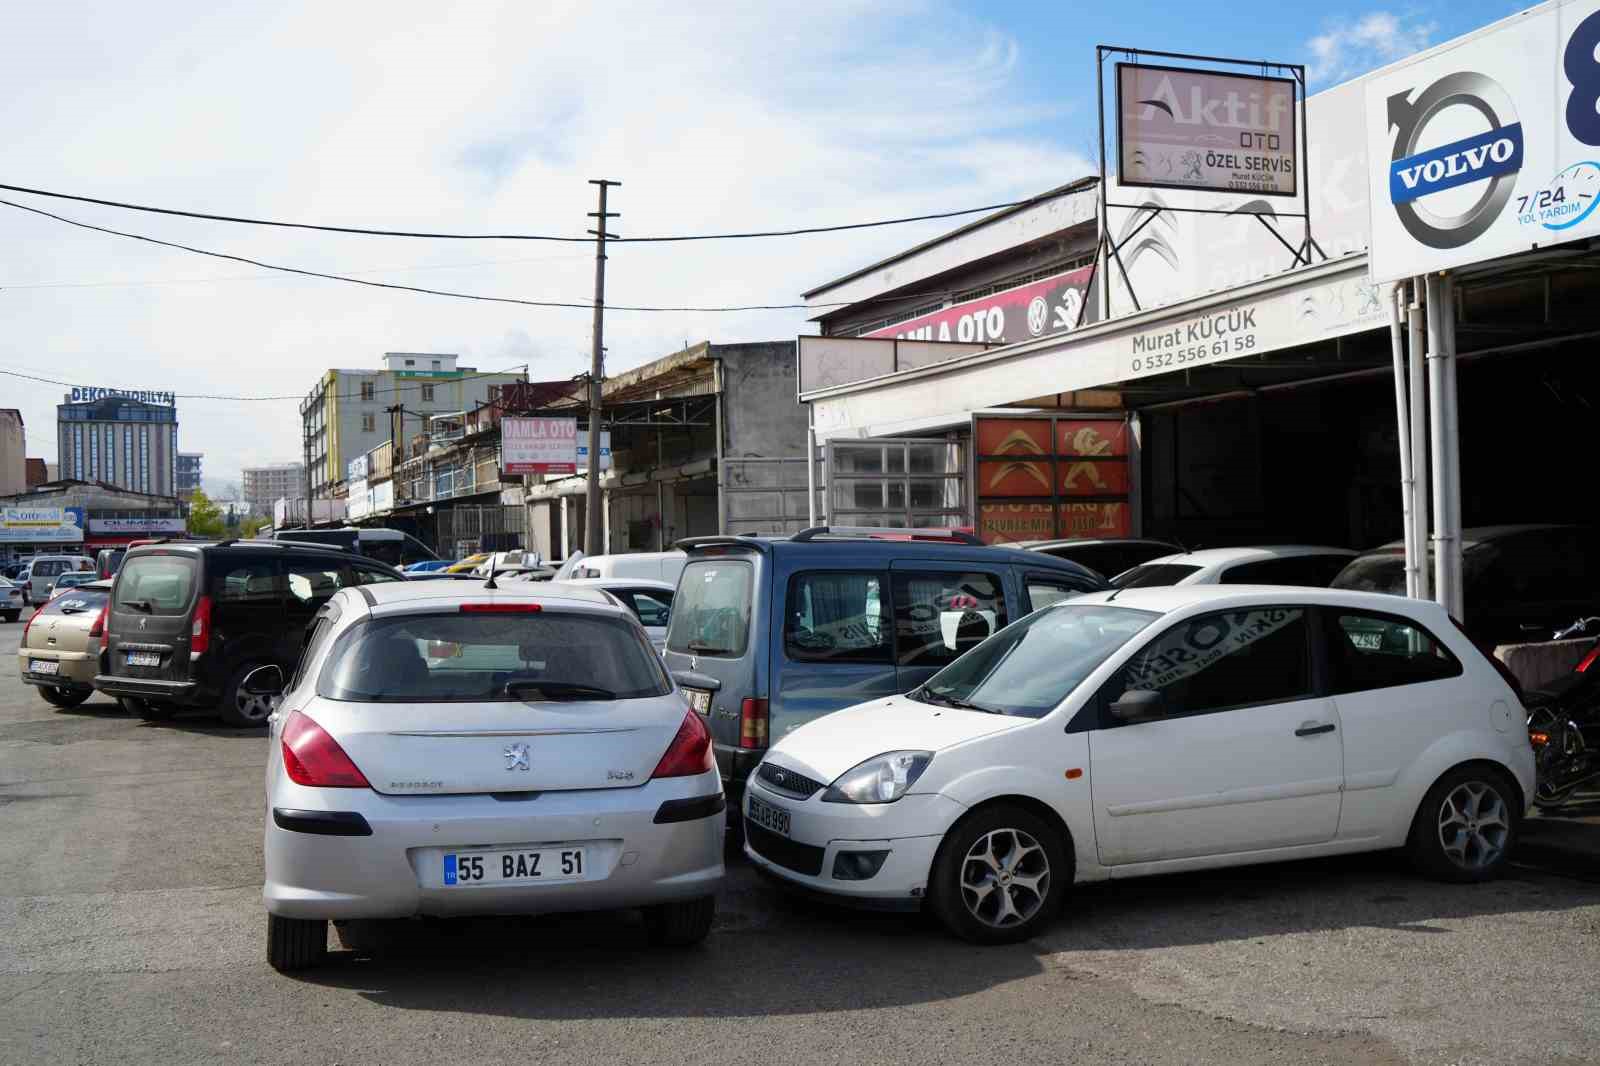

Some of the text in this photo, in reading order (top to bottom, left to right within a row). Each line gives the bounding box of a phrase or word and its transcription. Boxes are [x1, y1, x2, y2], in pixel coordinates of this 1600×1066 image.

[1139, 75, 1289, 130] Aktif
[1240, 131, 1280, 150] OTO
[1206, 150, 1292, 173] ÖZEL SERVİS
[1397, 138, 1514, 190] VOLVO
[1517, 187, 1566, 215] 7/24
[1518, 202, 1581, 225] YOL YARDIM
[957, 306, 1005, 343] OTO
[1132, 307, 1257, 354] Murat KÜÇÜK
[1132, 334, 1256, 372] 0 532 556 61 58
[504, 420, 575, 438] DAMLA OTO
[459, 851, 582, 880] 55 BAZ 51
